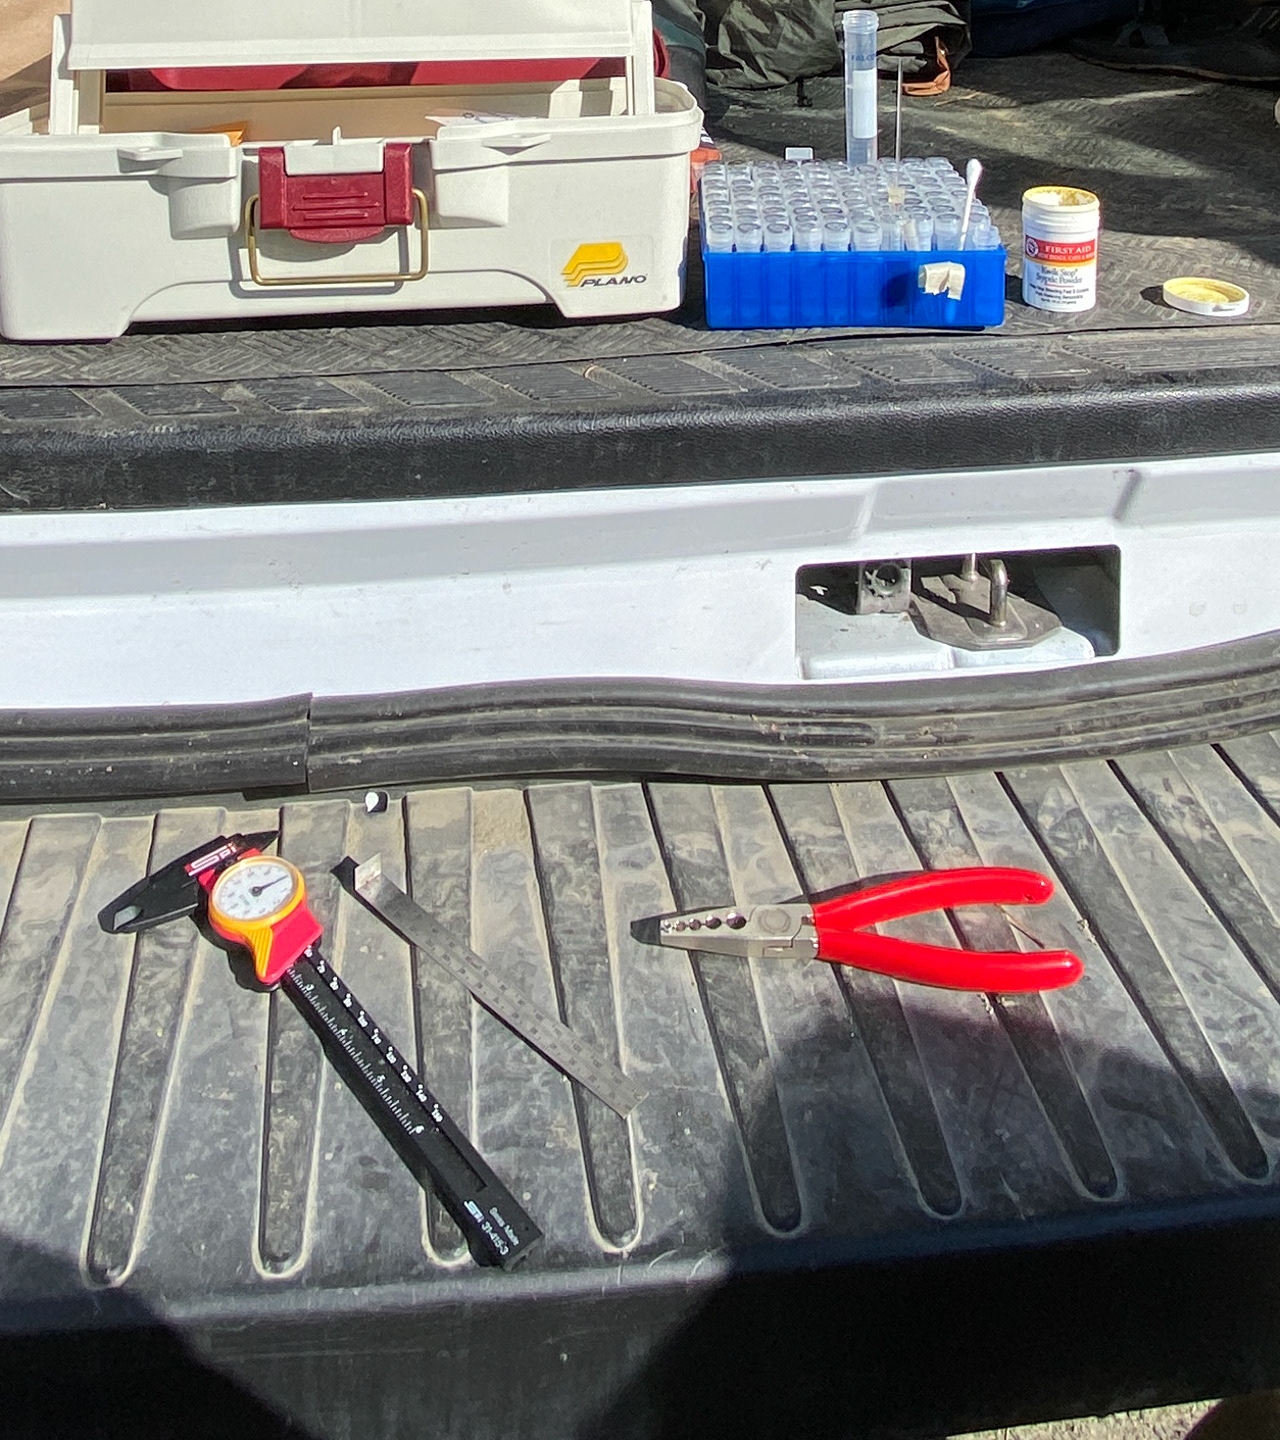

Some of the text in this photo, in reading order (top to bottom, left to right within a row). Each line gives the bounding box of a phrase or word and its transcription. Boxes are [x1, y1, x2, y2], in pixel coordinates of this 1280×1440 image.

[1045, 245, 1091, 254] FIRST AID
[580, 273, 647, 288] PLANO
